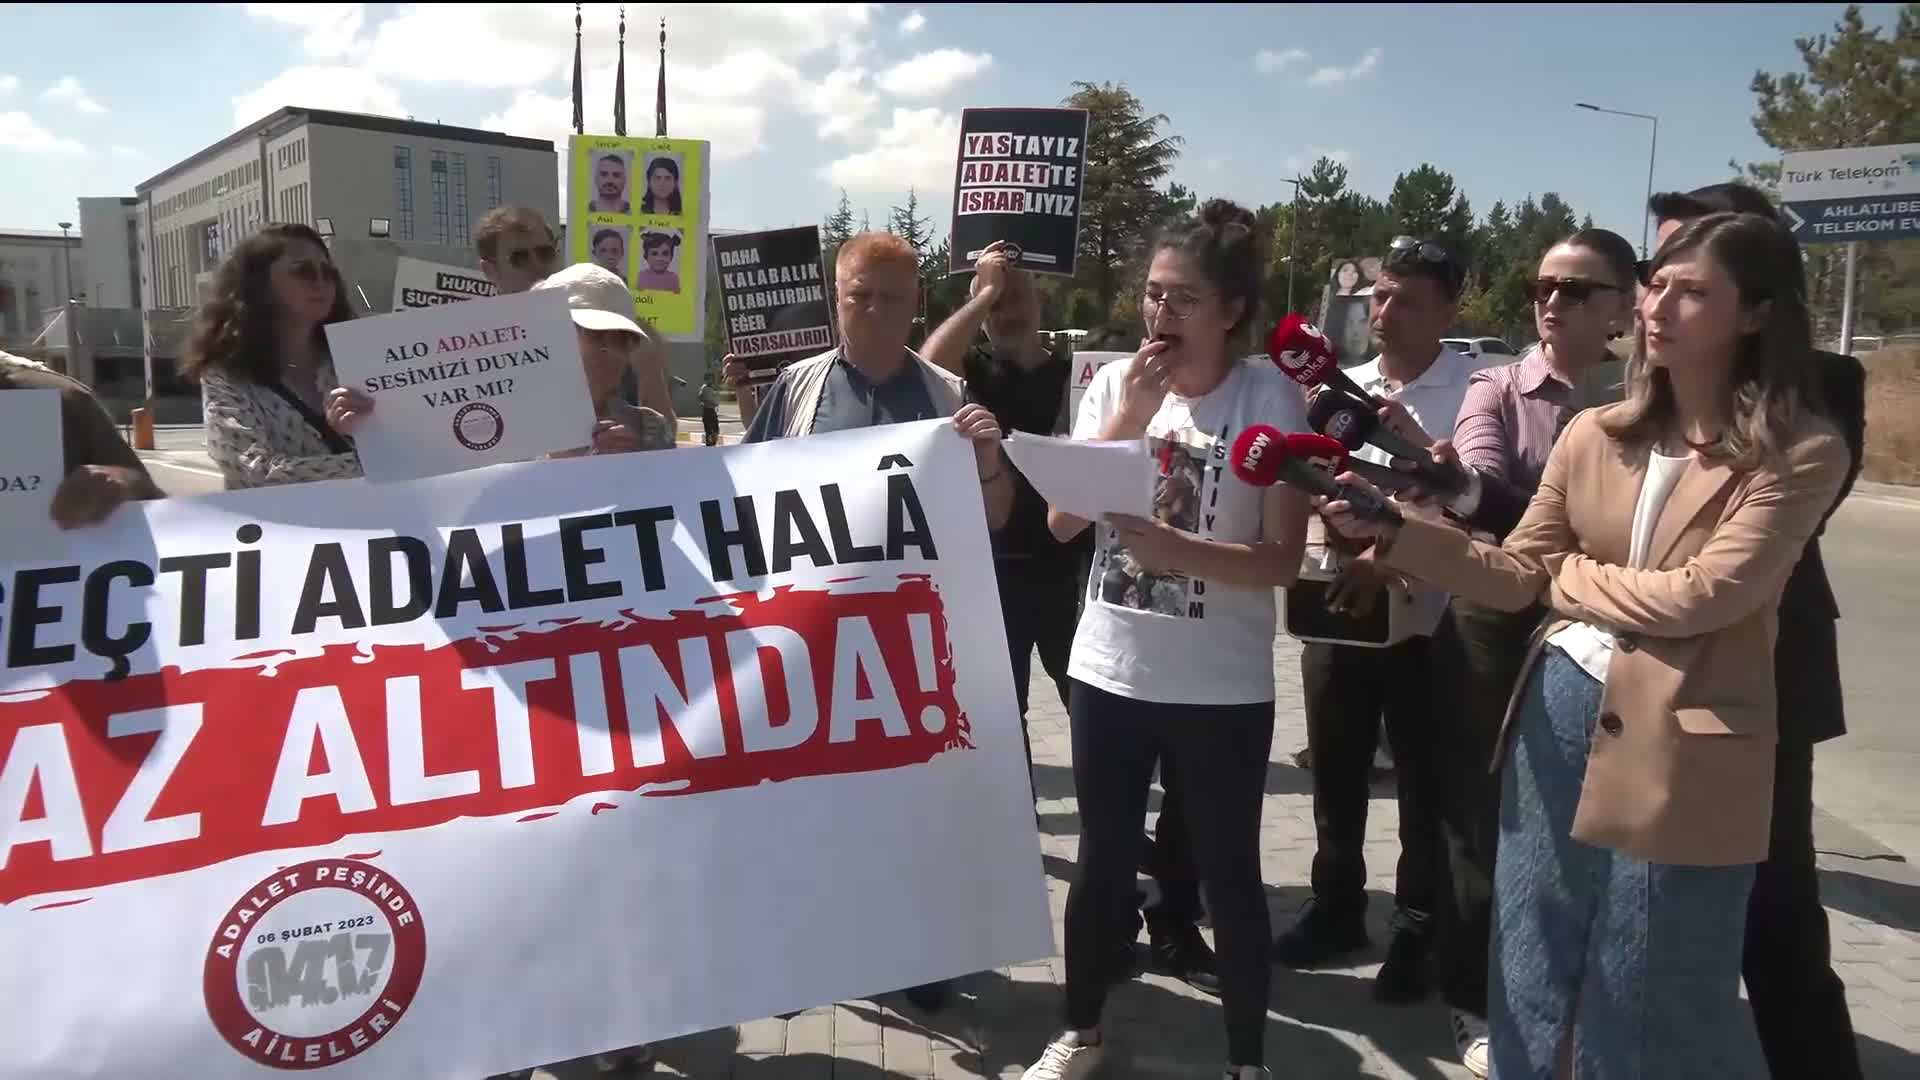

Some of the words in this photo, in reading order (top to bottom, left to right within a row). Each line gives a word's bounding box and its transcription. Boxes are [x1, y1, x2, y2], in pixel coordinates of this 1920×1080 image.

[967, 134, 1080, 158] YASTAYIZ
[962, 163, 1077, 187] ADALETTE
[1828, 164, 1901, 181] Telekom
[960, 191, 1075, 217] ISRARLIYIZ
[1812, 218, 1895, 235] TELEKOM
[719, 248, 760, 268] DAHA
[723, 263, 820, 290] KALABALIK
[727, 284, 823, 312] OLABİLİRDİK
[730, 313, 767, 334] EĞER
[384, 341, 429, 364] ALO
[434, 325, 527, 354] ADALET:
[364, 357, 471, 394] SESİMİZİ
[475, 345, 551, 374] DUYAN
[422, 385, 471, 409] VAR
[475, 378, 515, 400] MI?
[1241, 431, 1272, 472] NOW
[0, 523, 263, 681] EÇTİ
[290, 505, 676, 636] ADALET
[699, 453, 938, 582] HALÂ
[0, 703, 204, 870] AZ
[261, 612, 950, 829] ALTINDA!
[215, 872, 300, 960] ADALET
[315, 866, 415, 928] PEŞİNDE
[256, 932, 276, 945] 06
[280, 922, 333, 942] ŞUBAT
[337, 915, 375, 931] 2023
[240, 998, 402, 1063] AİLELERİ
